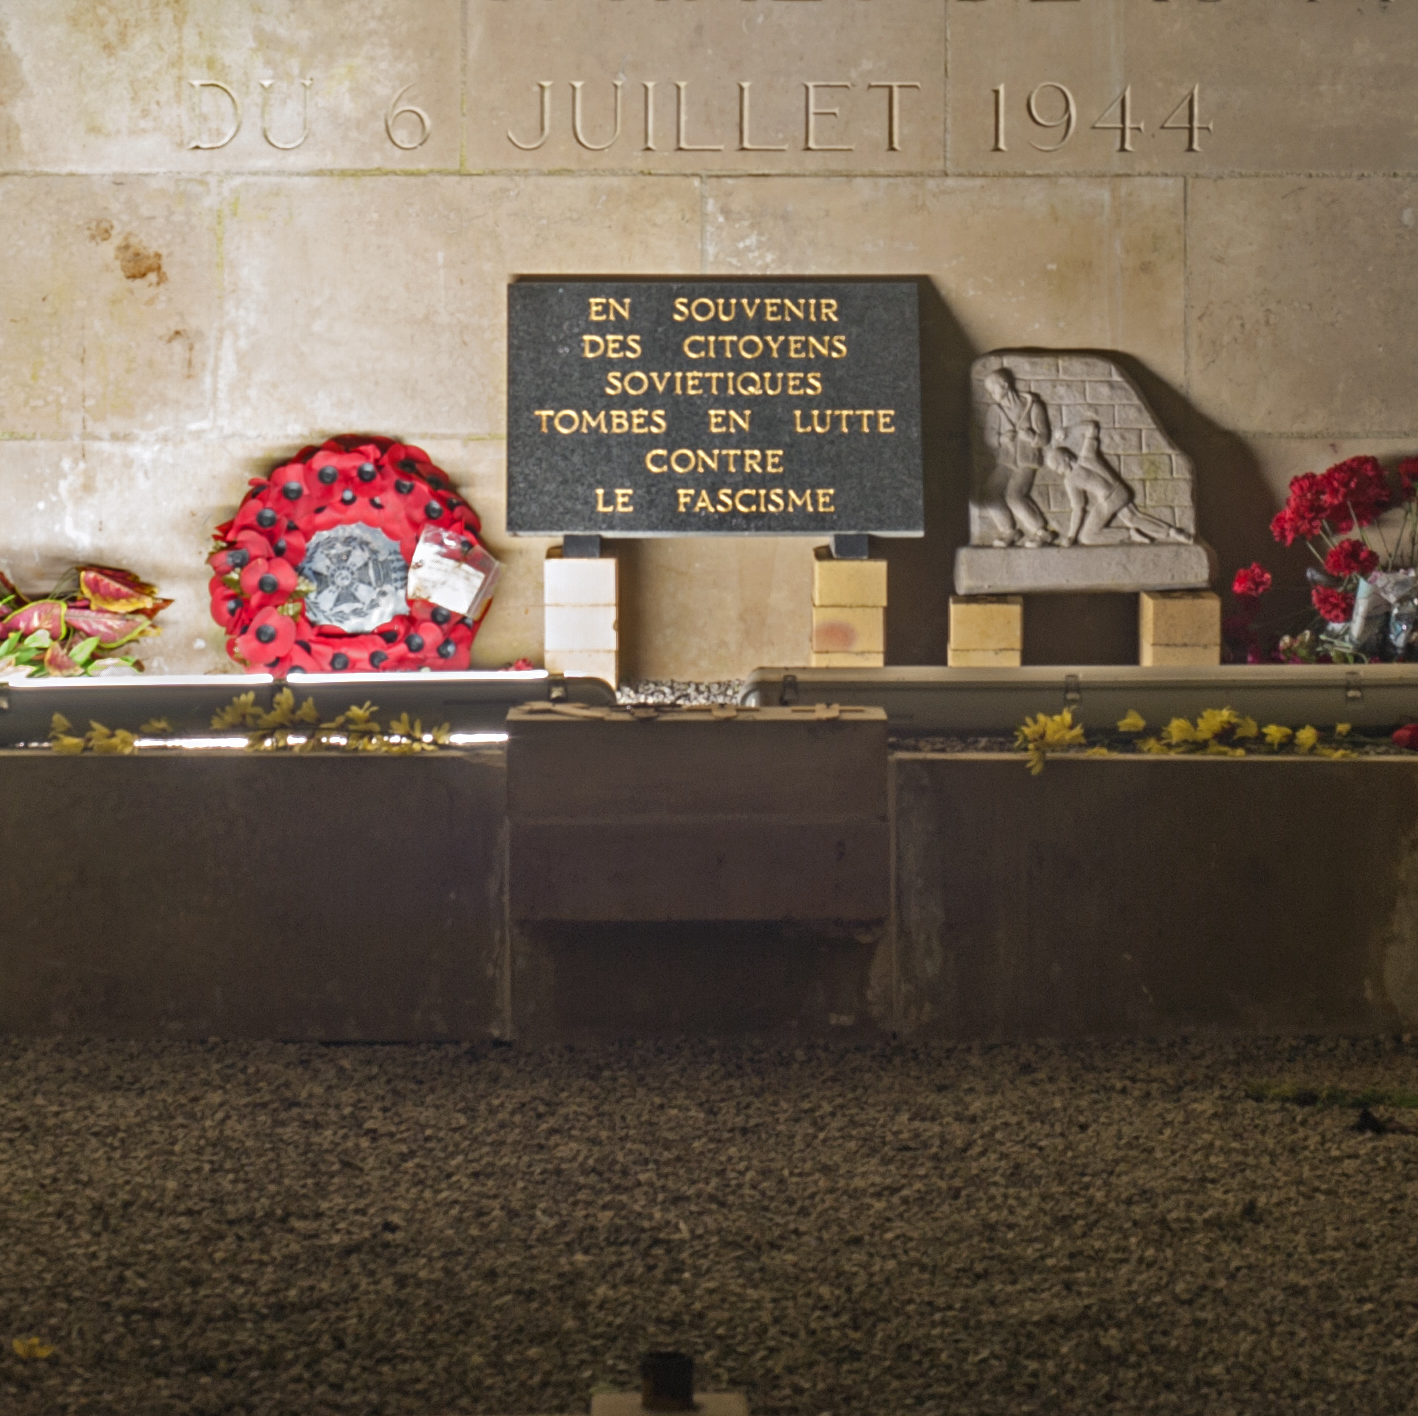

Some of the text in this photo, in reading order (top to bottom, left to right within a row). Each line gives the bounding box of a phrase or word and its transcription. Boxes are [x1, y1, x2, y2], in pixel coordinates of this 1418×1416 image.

[187, 80, 1214, 154] DU 6 JUILLET 1944
[588, 297, 839, 322] EN SOUVENIR
[583, 334, 847, 359] DES CITOYENS
[708, 409, 751, 433] EN
[794, 409, 895, 433] LUTTE
[645, 449, 784, 474] CONTRE
[595, 488, 836, 513] LE FASCISME
